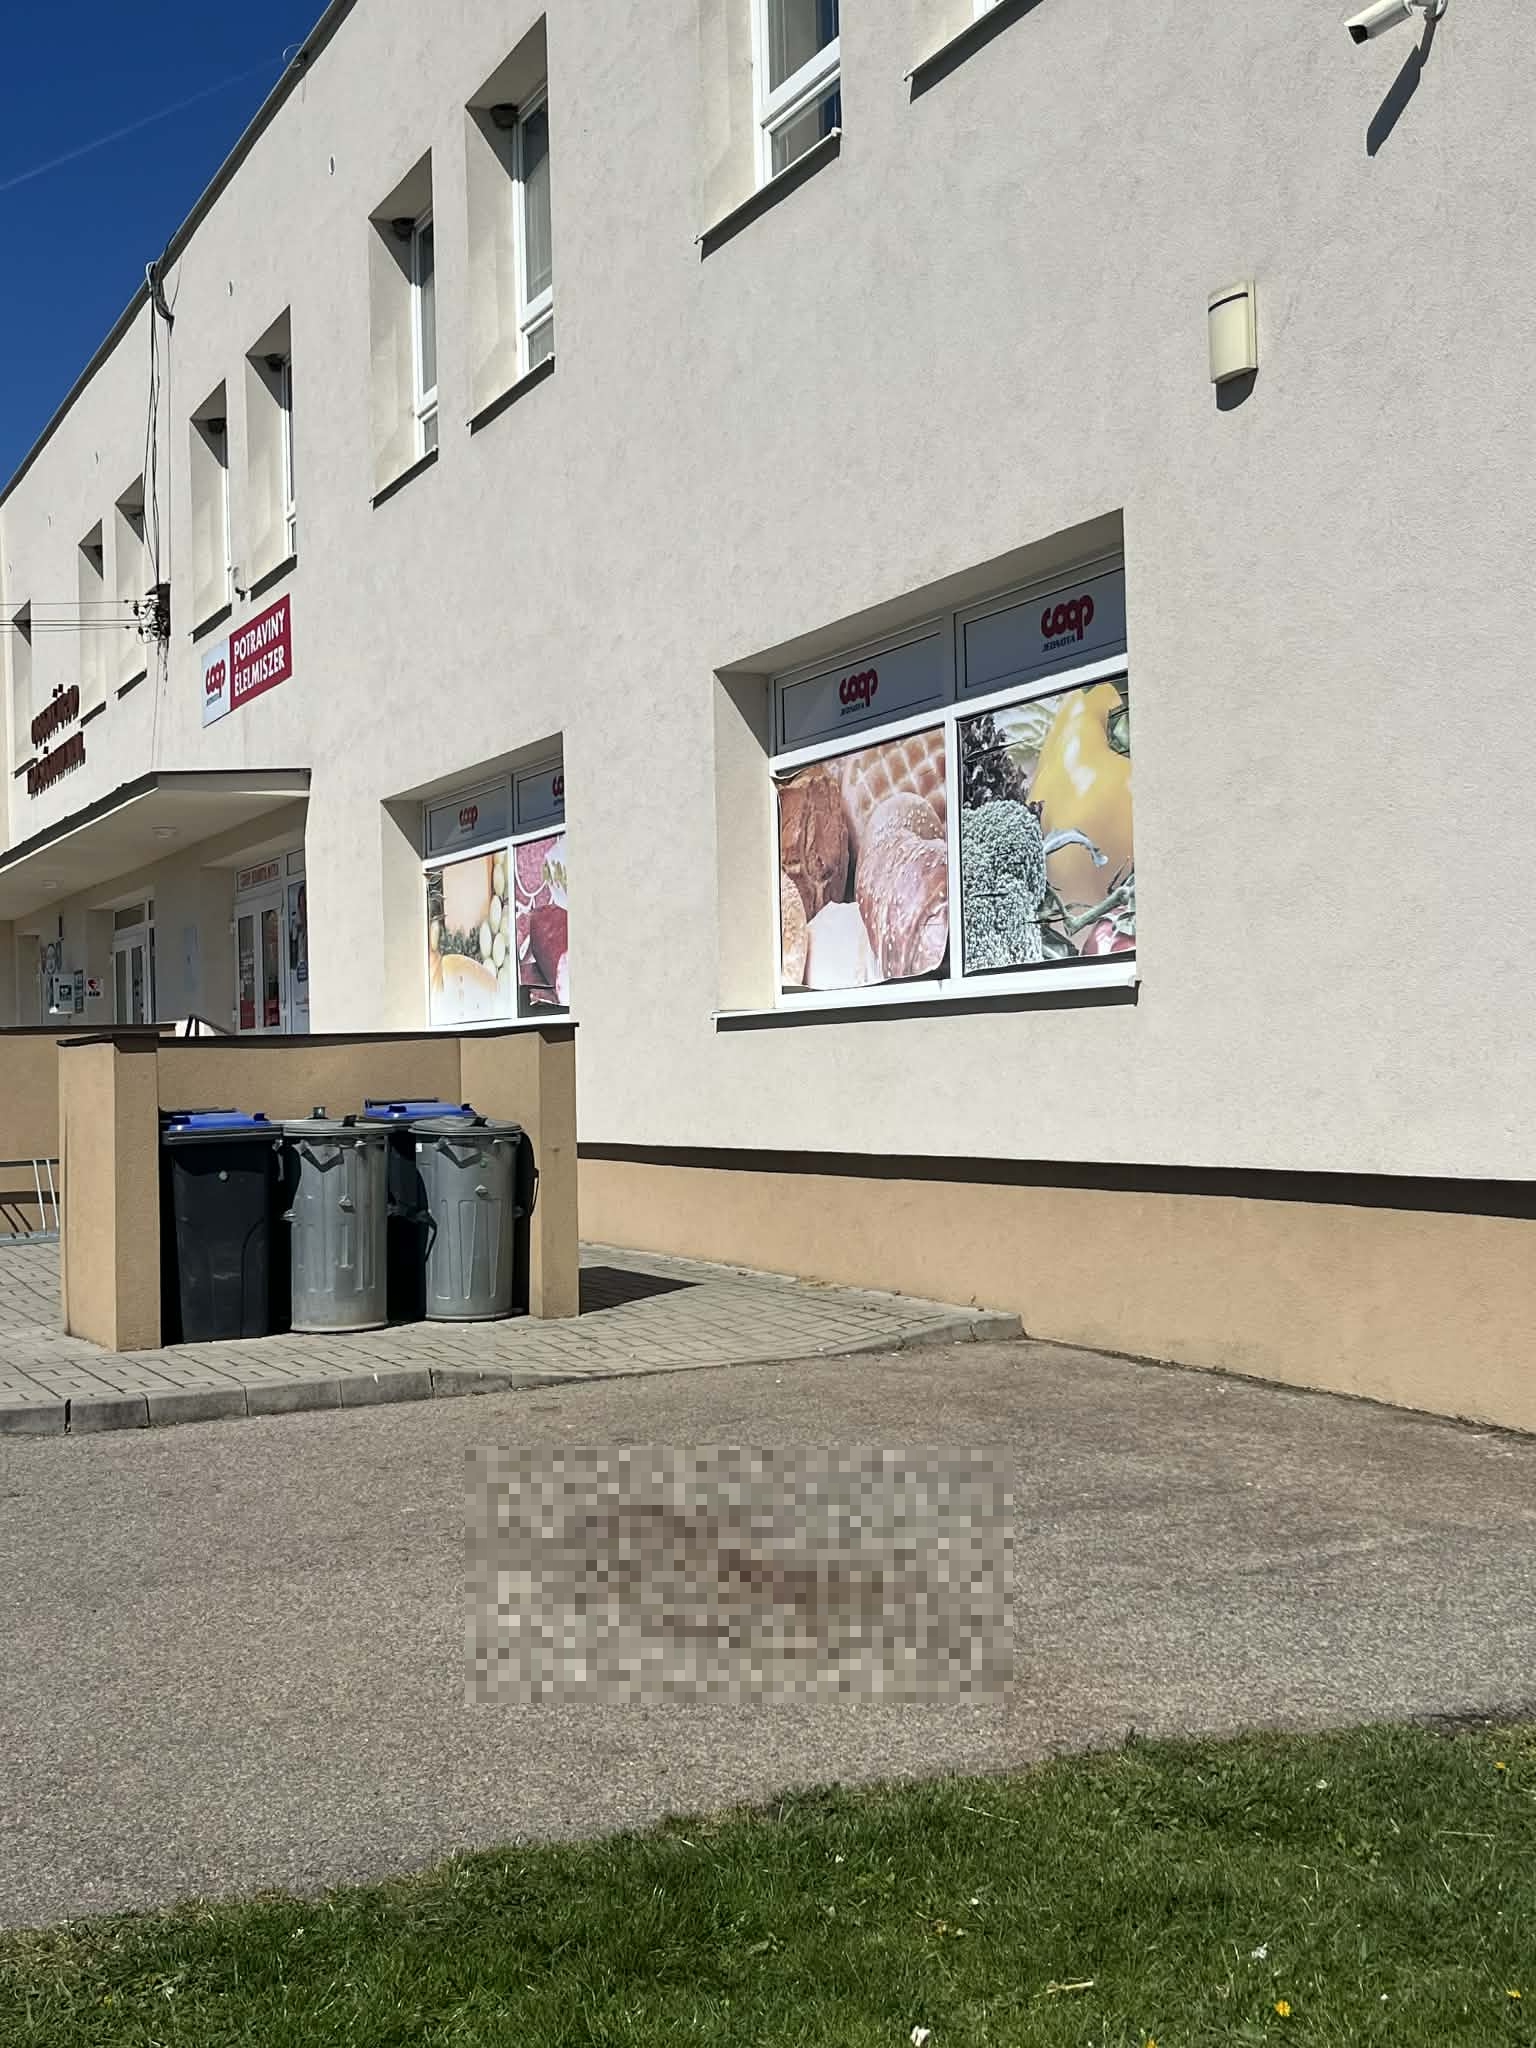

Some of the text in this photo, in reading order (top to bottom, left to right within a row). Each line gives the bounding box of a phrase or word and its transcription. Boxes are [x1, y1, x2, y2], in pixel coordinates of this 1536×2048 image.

[234, 607, 285, 664] POTRAVINY
[1040, 594, 1094, 640] coop
[205, 659, 226, 697] coop
[234, 645, 285, 697] ÉLELMISZER
[839, 668, 878, 708] coop
[459, 804, 478, 830] coop
